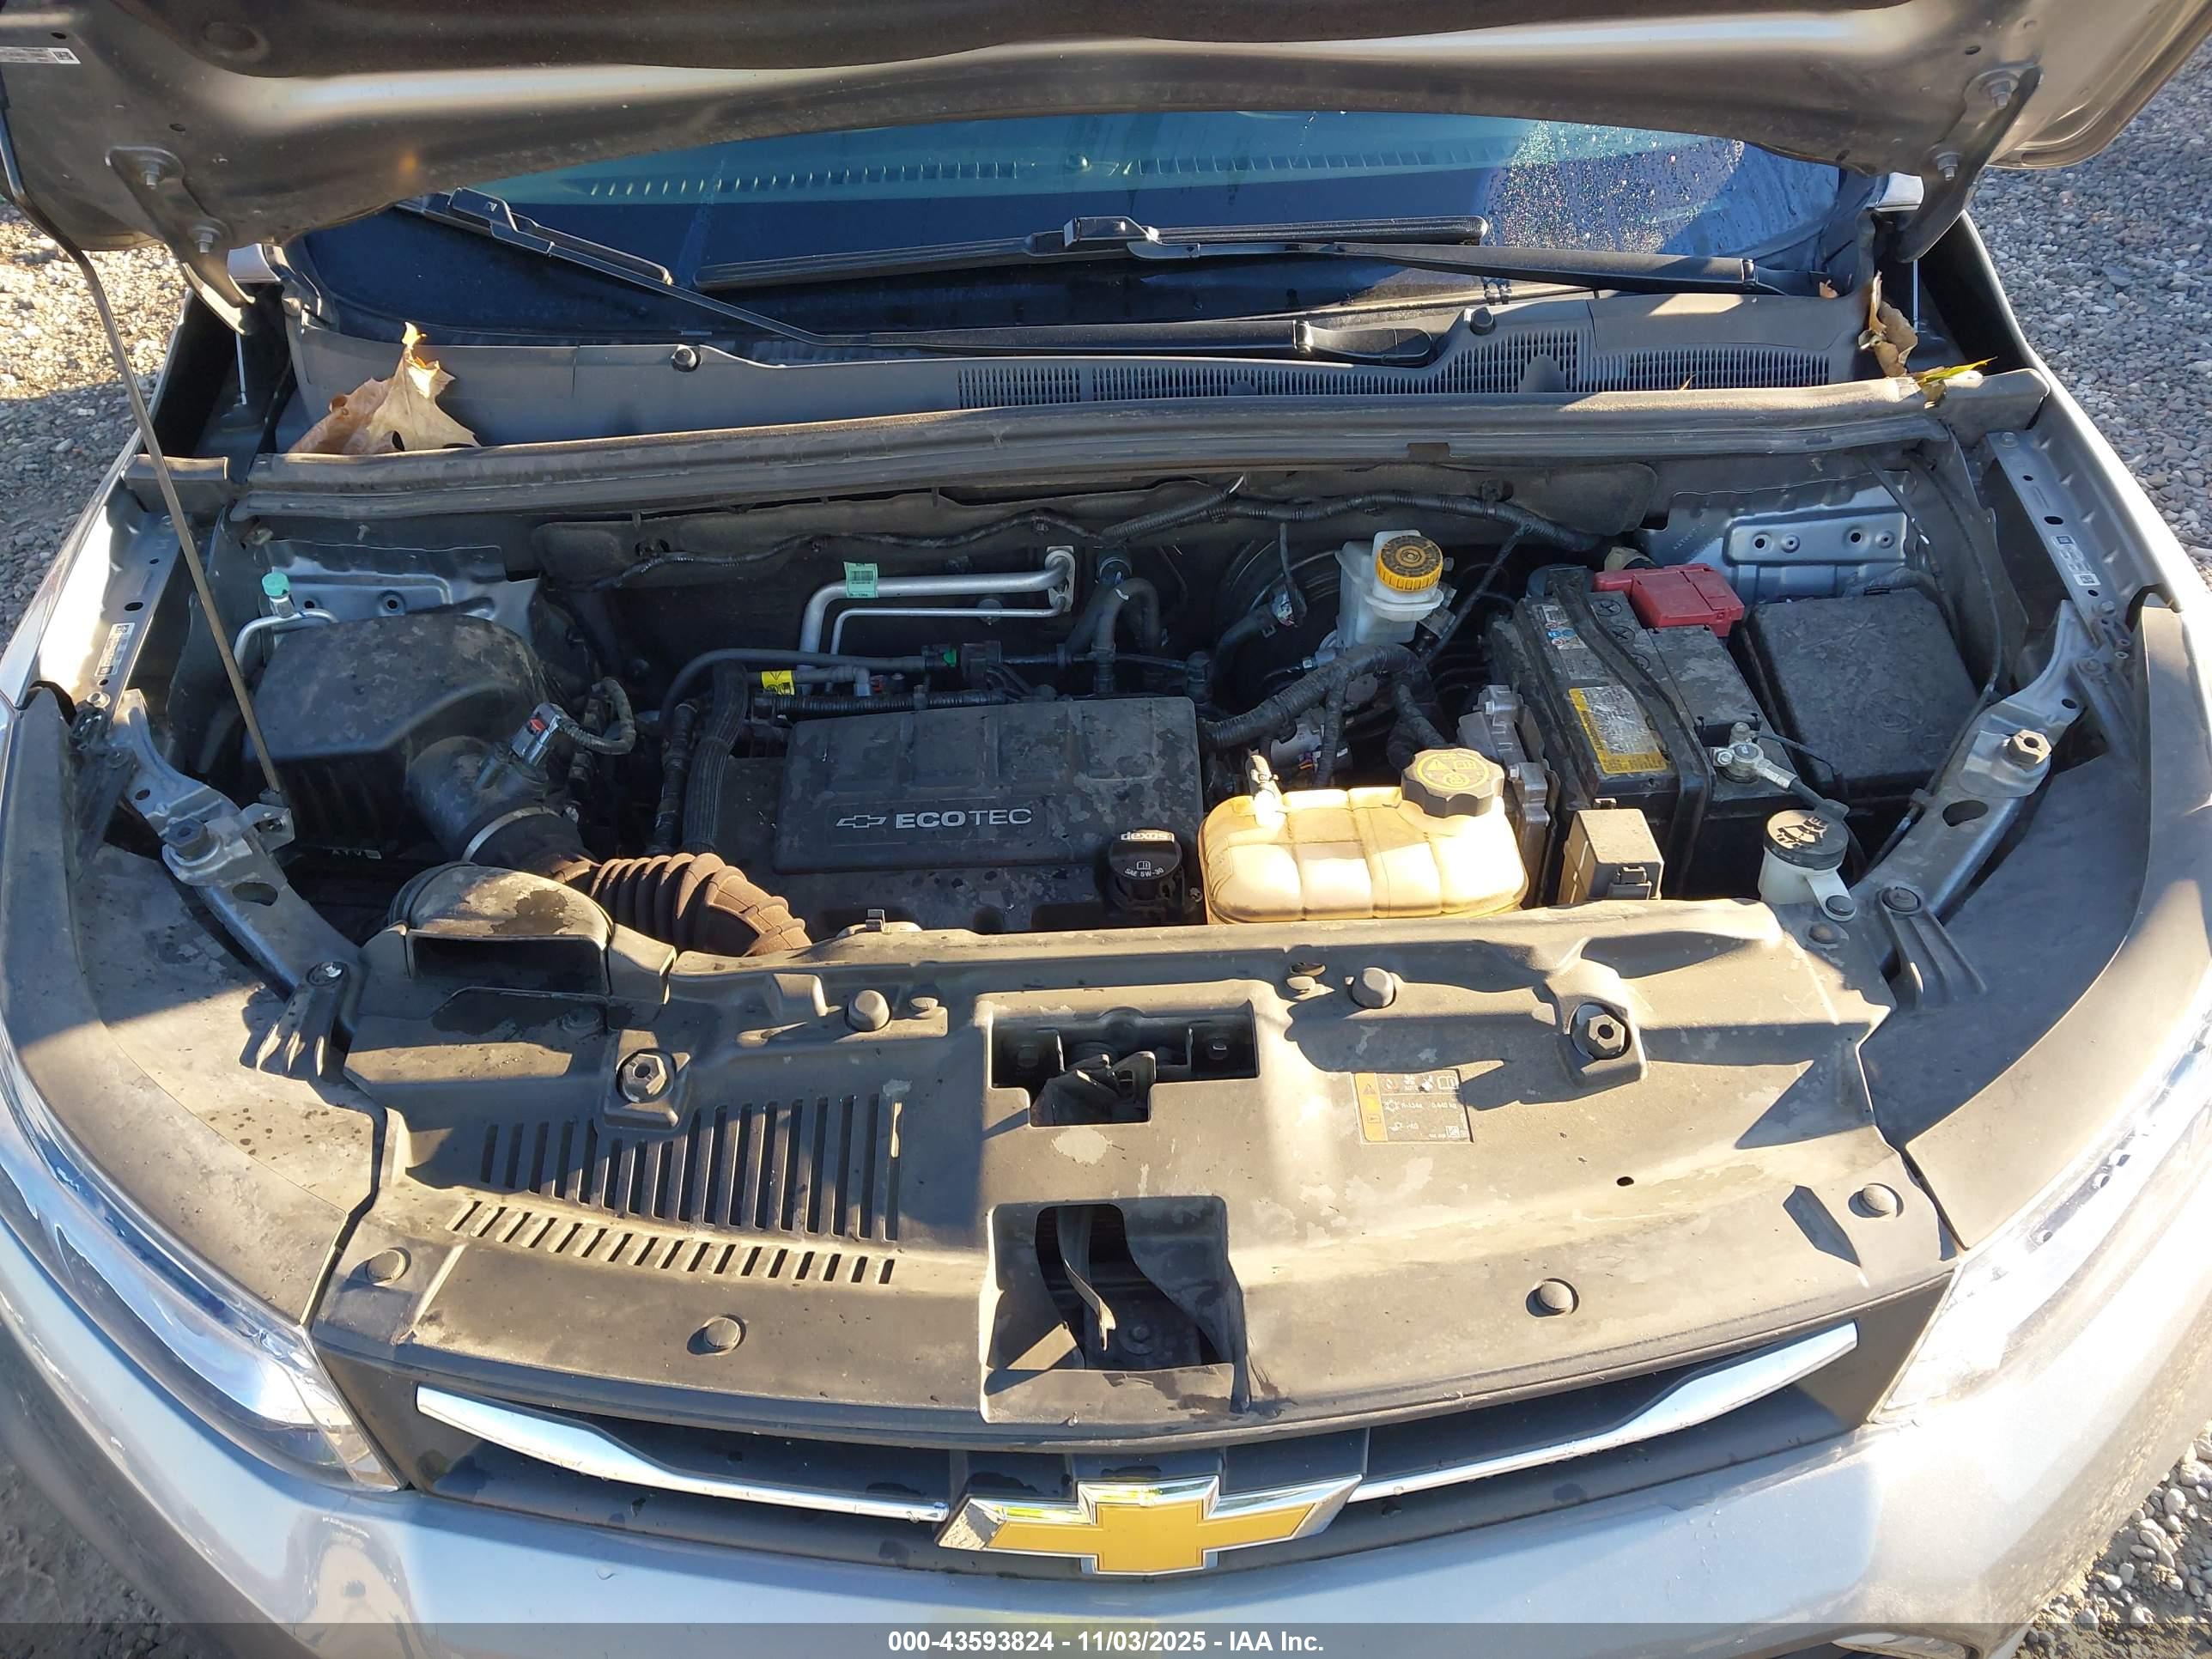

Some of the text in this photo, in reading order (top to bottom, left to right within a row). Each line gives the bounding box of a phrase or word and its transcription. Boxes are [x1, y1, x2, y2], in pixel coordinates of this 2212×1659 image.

[896, 809, 1032, 829] ECOTEC
[1124, 866, 1164, 878] SAE 5W-30
